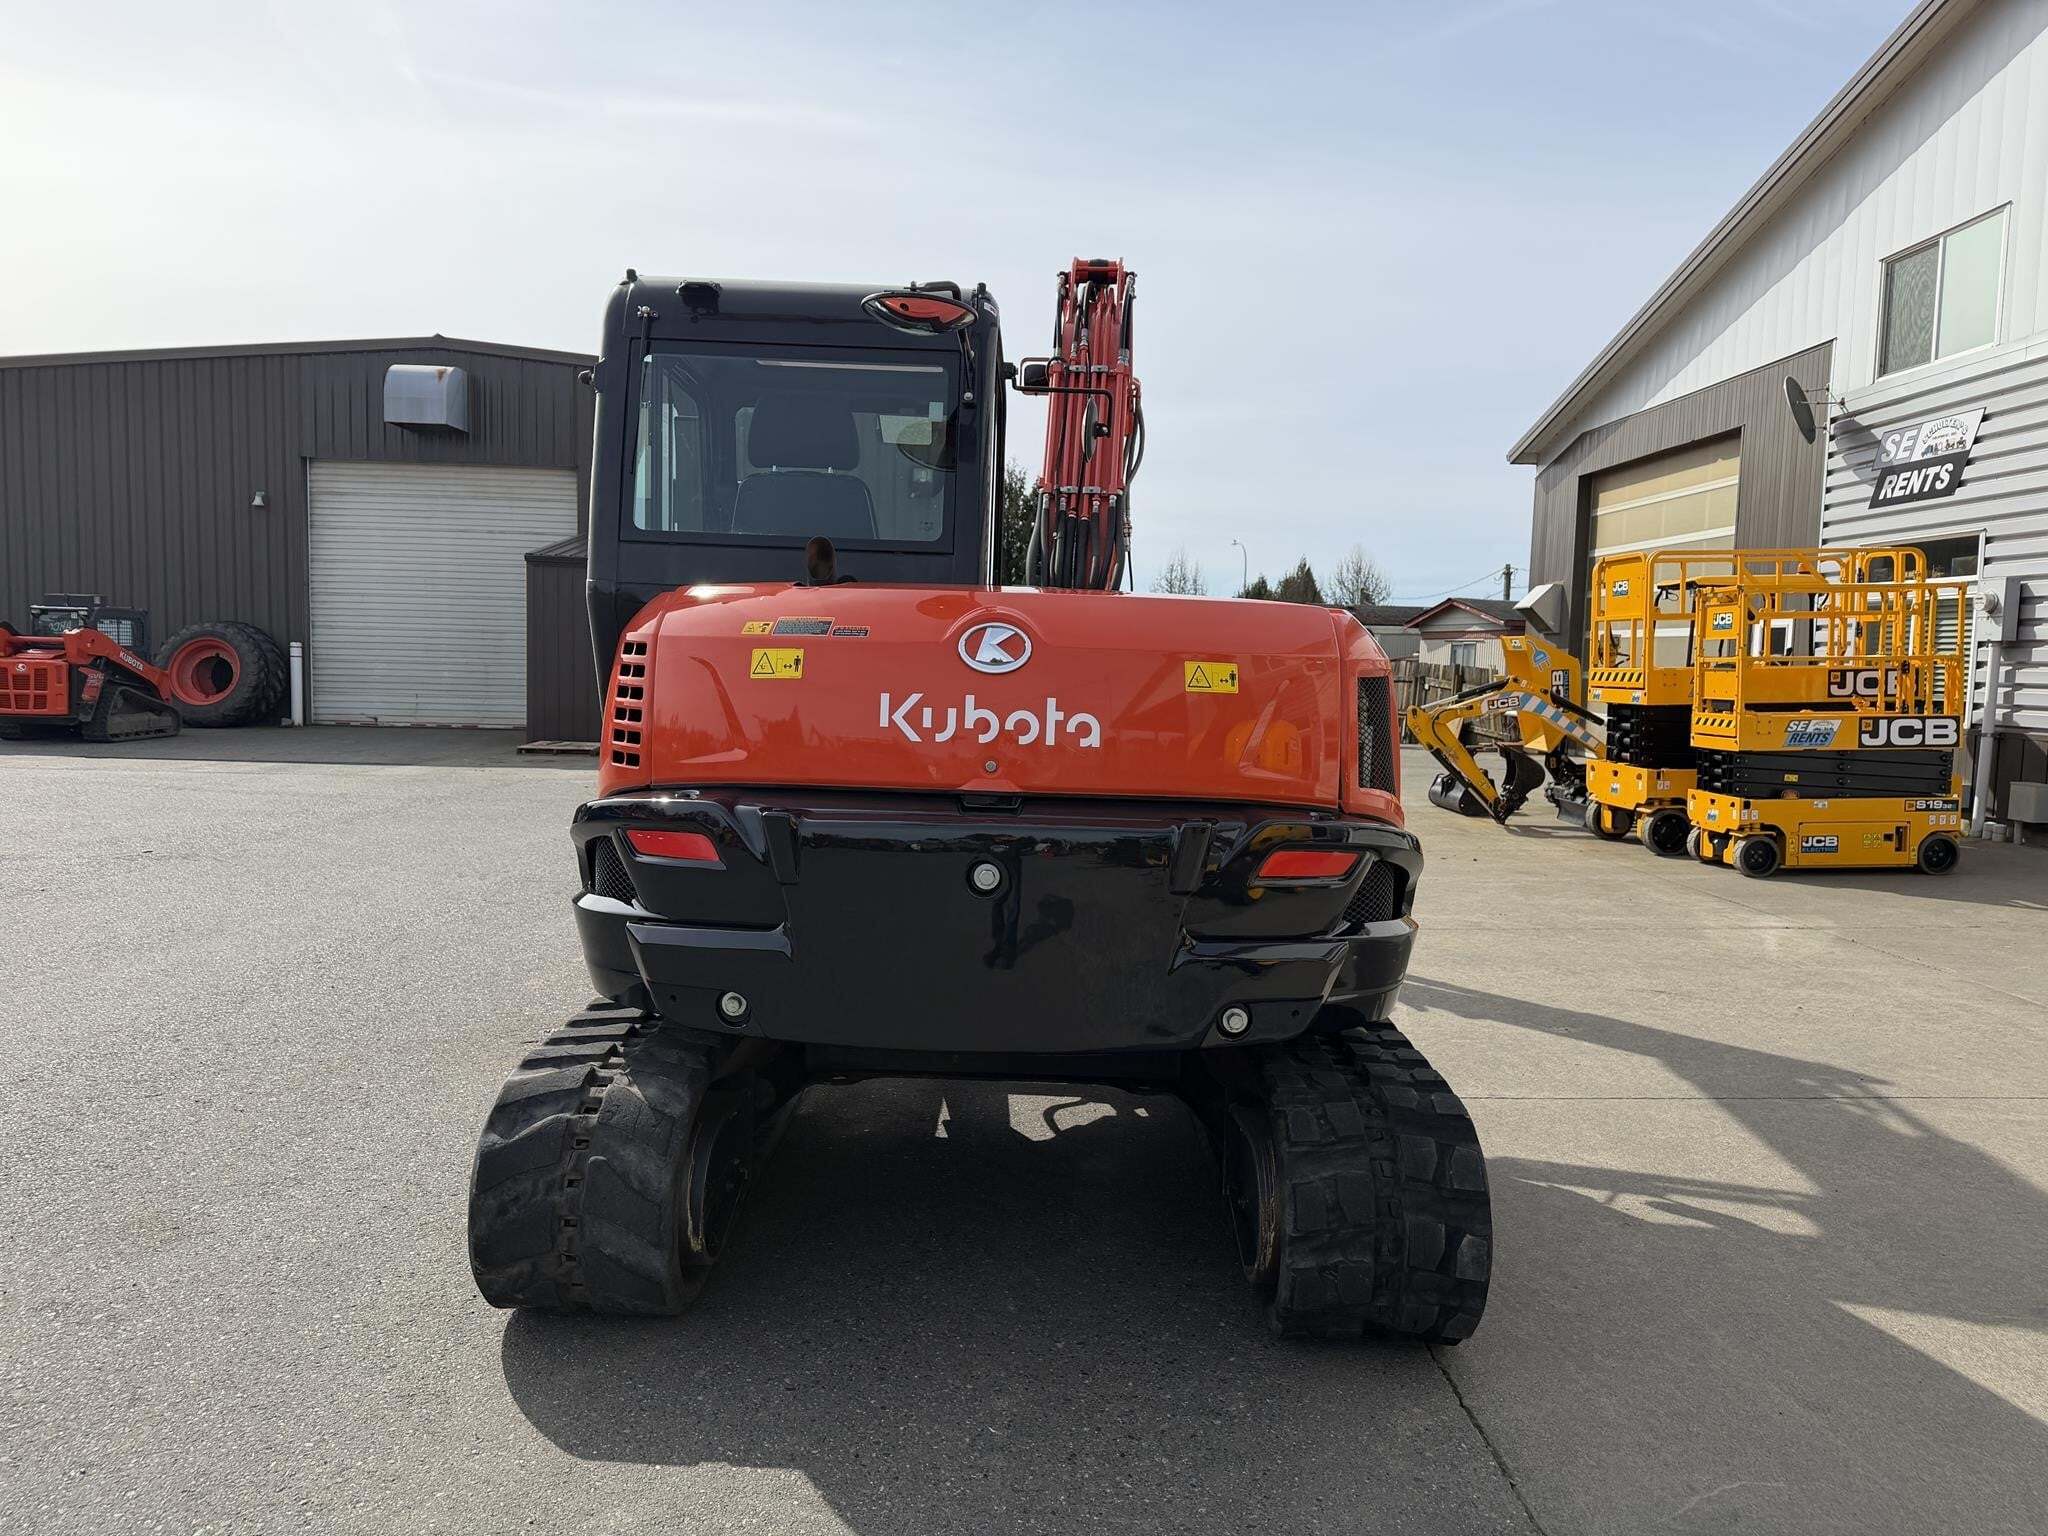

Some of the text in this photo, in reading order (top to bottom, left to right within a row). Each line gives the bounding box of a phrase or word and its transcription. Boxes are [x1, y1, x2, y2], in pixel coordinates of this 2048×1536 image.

[1880, 429, 1919, 462] SE
[1878, 463, 1954, 500] RENTS
[1612, 581, 1629, 592] JCB
[1713, 613, 1733, 625] JCB
[119, 650, 145, 671] KUBOTA
[1552, 670, 1564, 698] CB
[1489, 697, 1519, 709] JCB
[879, 692, 1101, 748] Kubota
[1787, 720, 1809, 732] SE
[1788, 732, 1831, 744] RENTS
[1861, 718, 1958, 746] JCB
[1802, 836, 1838, 847] JCB
